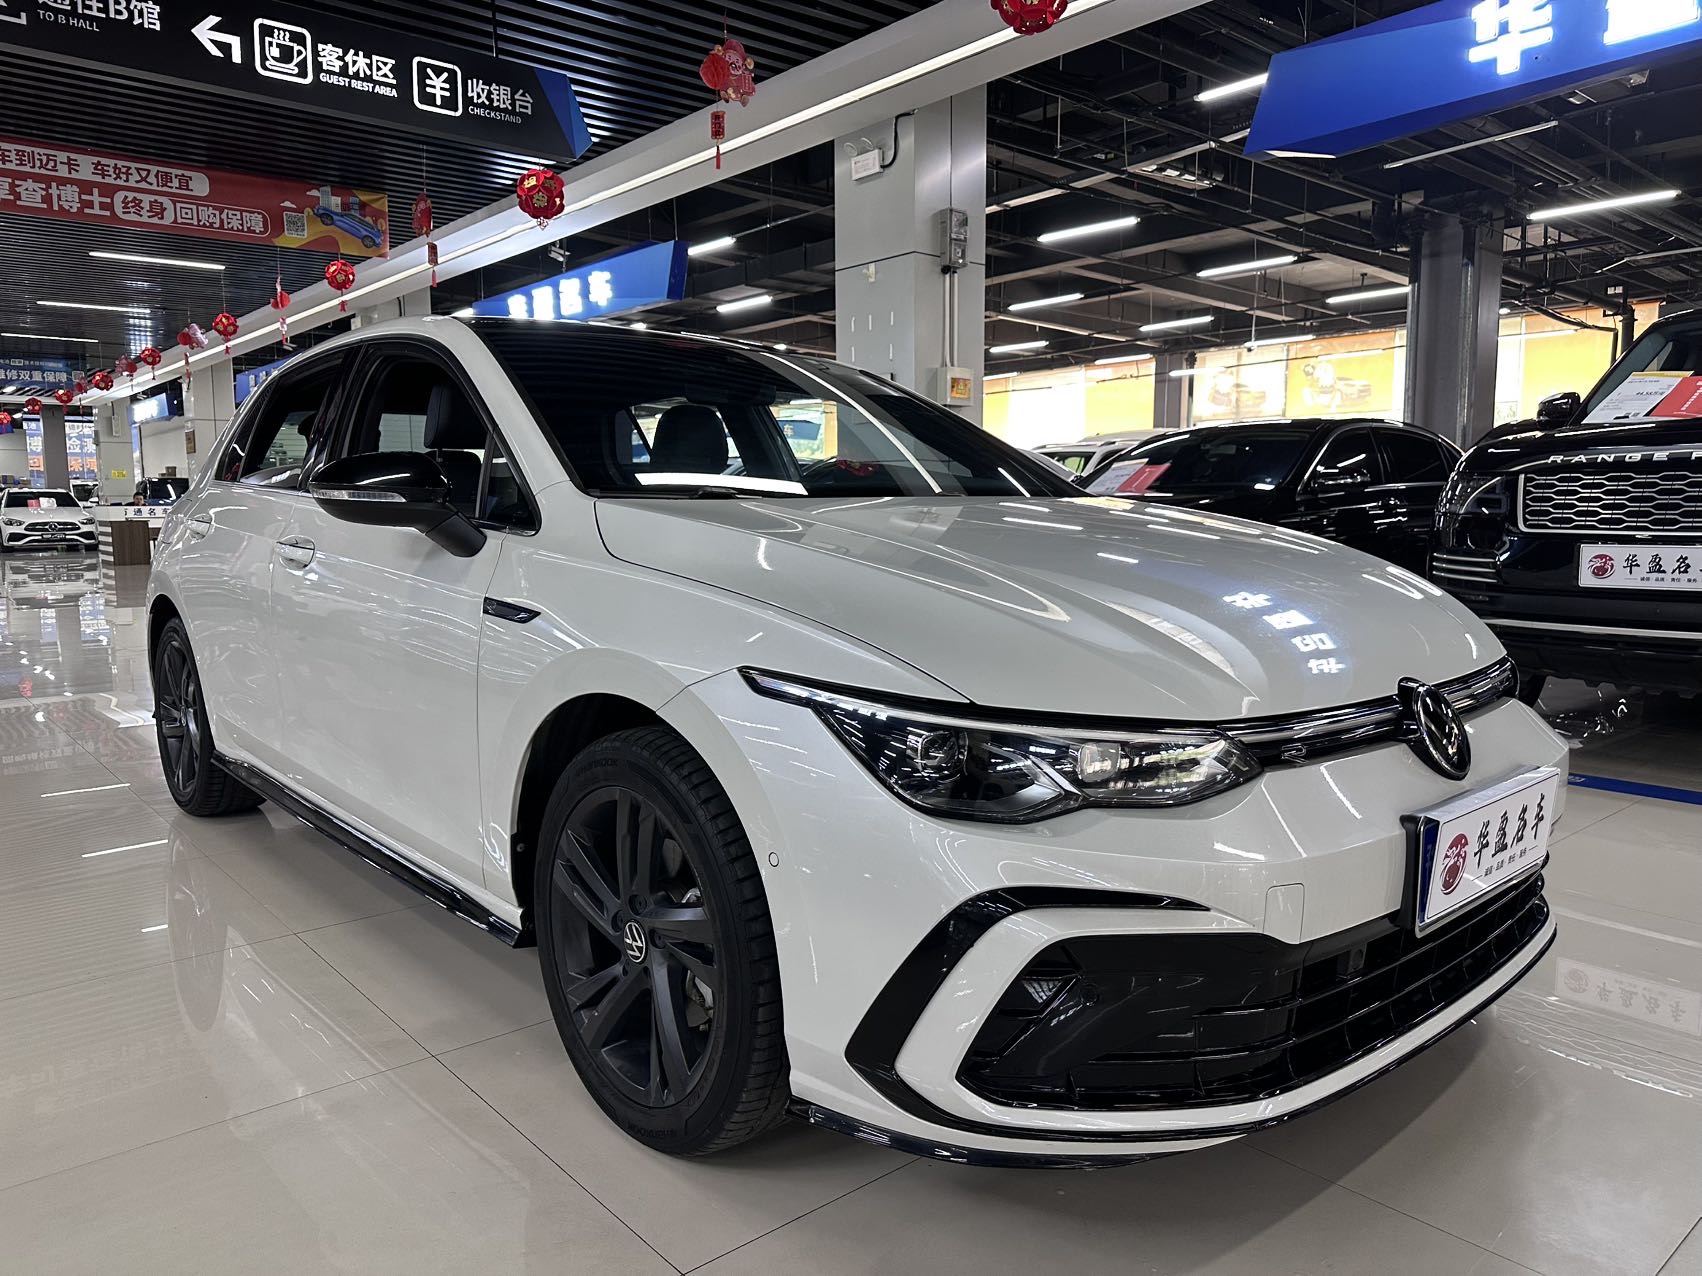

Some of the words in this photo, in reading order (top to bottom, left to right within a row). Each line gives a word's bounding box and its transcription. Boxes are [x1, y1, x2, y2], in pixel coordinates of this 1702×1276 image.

[36, 9, 55, 21] TO
[58, 14, 66, 24] B
[69, 17, 100, 32] HALL
[317, 43, 397, 85] 客休区
[319, 72, 350, 88] GUEST
[350, 79, 374, 93] REST
[374, 86, 398, 98] AREA
[467, 78, 533, 115] 收银台
[468, 106, 522, 124] CHECKSTAND
[91, 160, 194, 193] 车好又便宜
[1547, 452, 1670, 464] RANGE
[1623, 553, 1702, 575] 华盈名
